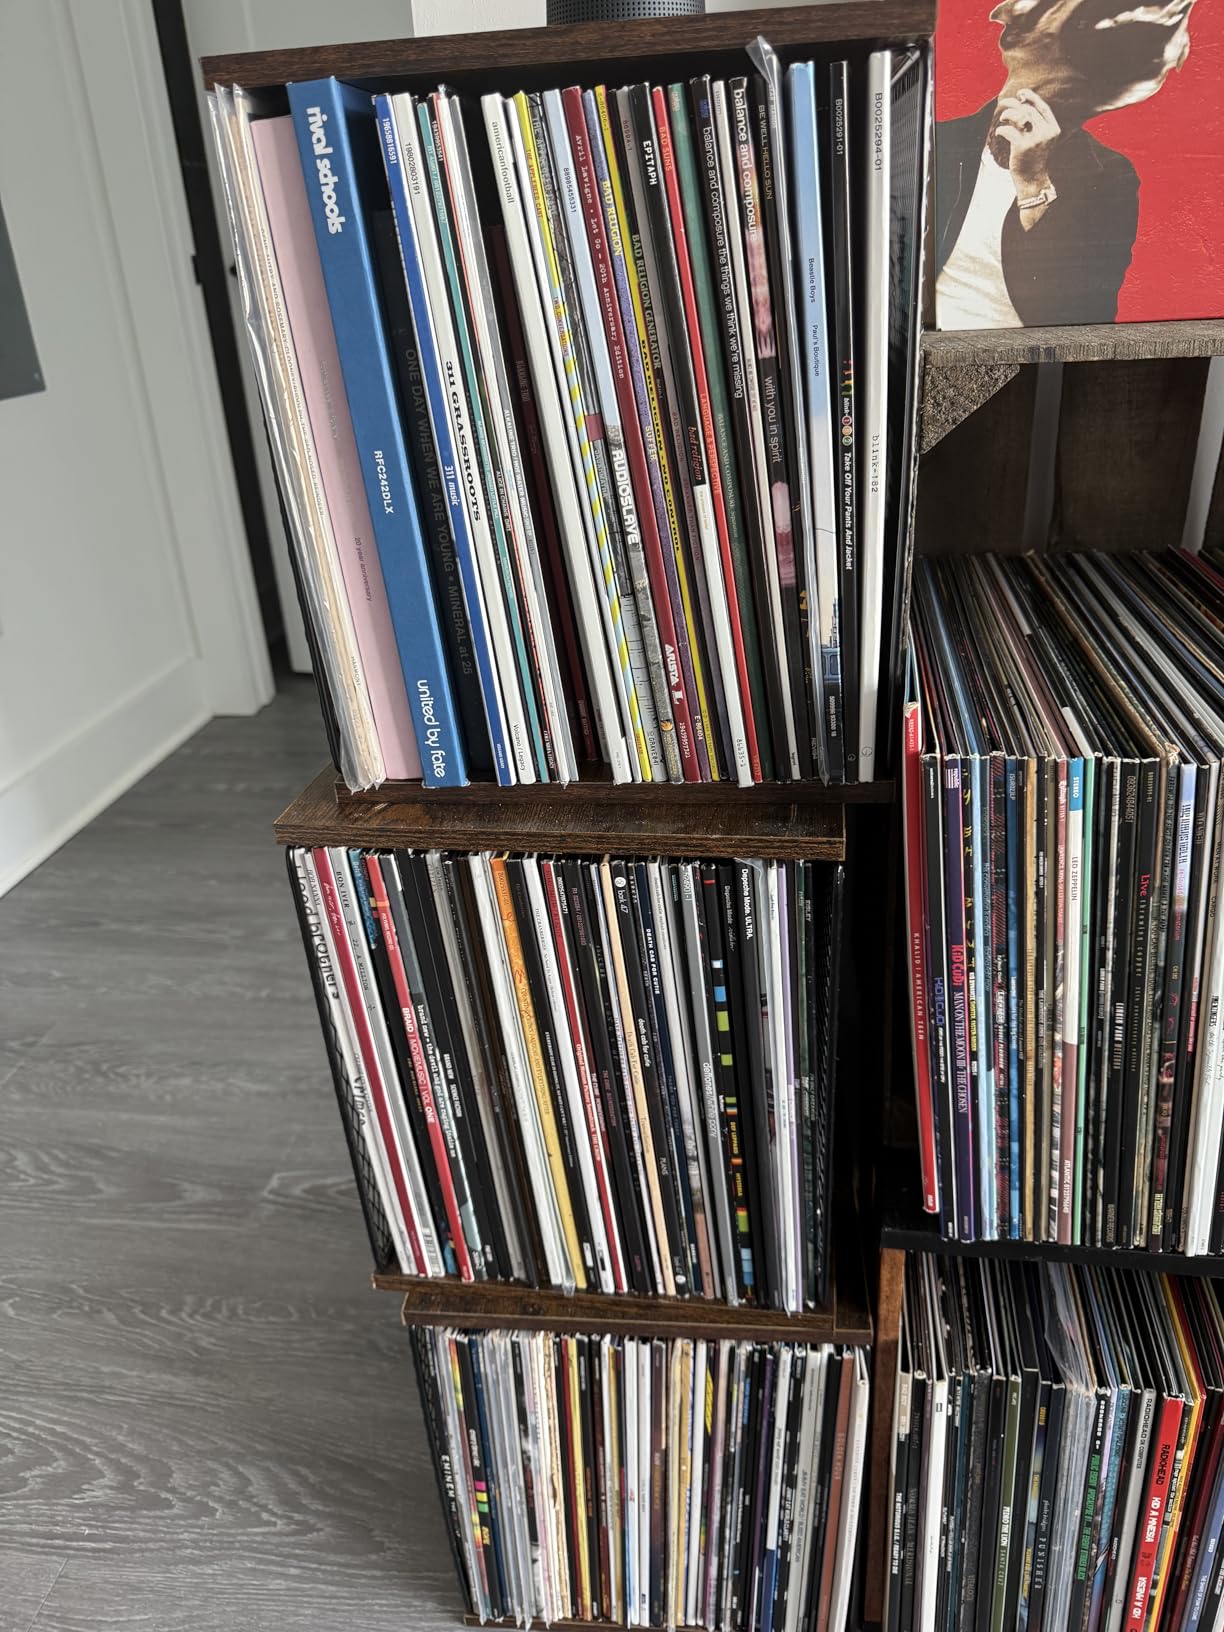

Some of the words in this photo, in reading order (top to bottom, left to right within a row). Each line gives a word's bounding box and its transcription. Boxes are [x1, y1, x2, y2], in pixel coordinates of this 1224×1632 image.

[732, 88, 748, 141] balance
[305, 104, 334, 156] rival
[381, 117, 397, 164] 19658816591
[872, 92, 883, 171] B0025294-01
[574, 134, 586, 161] Avril
[702, 126, 716, 167] balance
[739, 143, 752, 168] and
[404, 142, 420, 195] 19802803191
[491, 120, 515, 204] americanfootball
[642, 140, 657, 185] EPITAPH
[579, 165, 594, 204] Lavigne
[602, 179, 614, 203] BAD
[707, 169, 718, 189] and
[313, 155, 349, 234] schools
[741, 170, 758, 241] composure
[590, 217, 600, 234] Let
[606, 206, 622, 256] RELIGION
[708, 190, 725, 246] composure
[631, 233, 642, 256] BAD
[717, 247, 727, 263] the
[599, 262, 609, 284] 20th
[635, 259, 651, 308] RELIGION
[718, 265, 731, 294] things
[601, 286, 620, 341] Anniversary
[725, 312, 736, 335] think
[644, 309, 661, 369] GENERATOR
[729, 337, 740, 362] we're
[403, 348, 421, 382] ONE
[445, 360, 456, 387] 311
[613, 345, 625, 379] Edition
[731, 363, 743, 398] missing
[764, 376, 776, 399] with
[409, 384, 427, 415] DAY
[764, 401, 777, 422] you
[415, 417, 436, 463] WHEN
[644, 425, 656, 461] SUFFER
[687, 425, 698, 443] bad
[769, 424, 779, 434] in
[450, 391, 481, 521] GRASSROOTS
[688, 444, 703, 481] religion
[769, 437, 782, 463] spirit
[870, 435, 880, 493] blink-182
[372, 449, 395, 514] RFC242DLX
[424, 465, 440, 489] WE
[444, 464, 455, 479] 311
[429, 491, 446, 521] ARE
[447, 480, 460, 506] music
[611, 448, 638, 545] AUDIOSLAVE
[434, 524, 455, 572] YOUNG
[446, 584, 468, 643] MINERAL
[458, 645, 470, 659] at
[460, 659, 473, 675] 25
[664, 643, 679, 686] ARISTA
[416, 678, 438, 726] united
[422, 727, 442, 747] by
[430, 748, 449, 778] fate
[617, 889, 627, 902] bark
[740, 868, 750, 894] Depeche
[952, 991, 963, 1009] MAN
[953, 1009, 964, 1021] ON
[1114, 1002, 1125, 1024] LINKIN
[954, 1021, 965, 1036] THE
[1113, 1025, 1123, 1041] PARK
[954, 1036, 966, 1059] MOON
[401, 1006, 415, 1033] BRAID
[408, 1037, 427, 1085] MOVIEMUSIC
[424, 1105, 434, 1124] ONE
[416, 1004, 428, 1024] brand
[428, 1054, 438, 1072] devil
[433, 1085, 443, 1097] god
[438, 1108, 449, 1129] raging
[444, 1129, 455, 1148] inside
[956, 1070, 966, 1082] THE
[956, 1082, 968, 1113] CHOSEN
[707, 1119, 718, 1138] pony
[1139, 1398, 1152, 1438] RADIOHEAD
[440, 1454, 455, 1498] EMINEM
[1155, 1443, 1170, 1485] RADIOHEAD
[1150, 1496, 1161, 1509] KID
[1144, 1516, 1157, 1543] MNESIA
